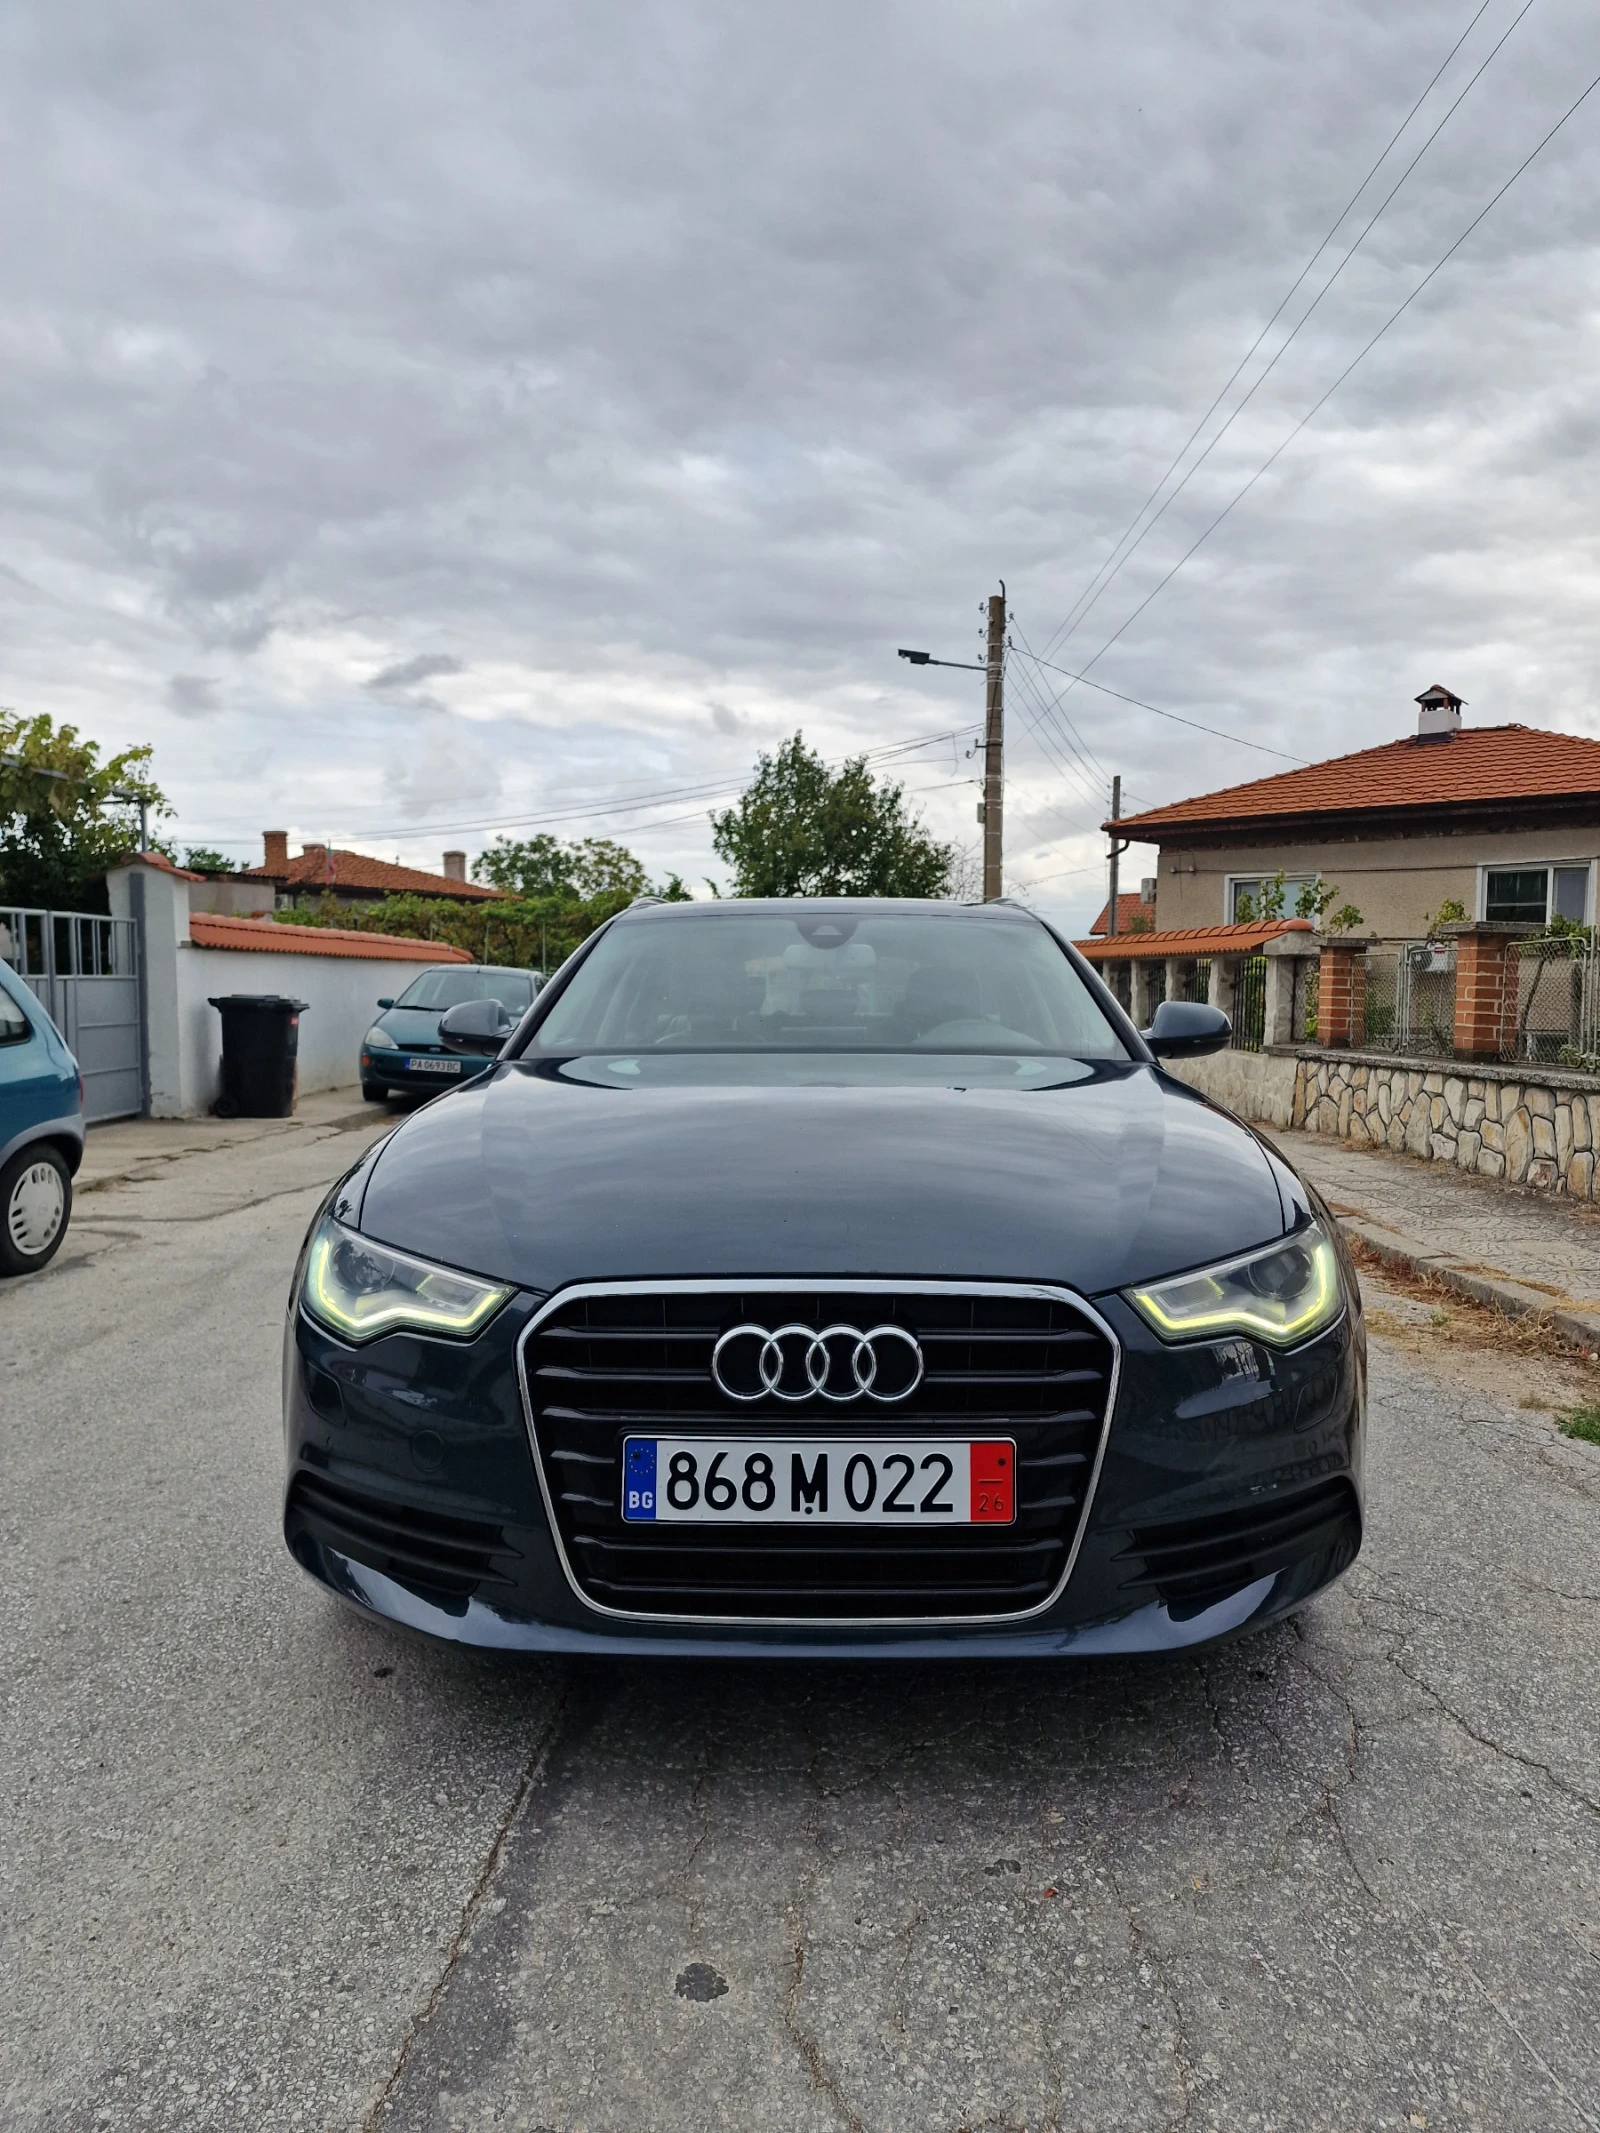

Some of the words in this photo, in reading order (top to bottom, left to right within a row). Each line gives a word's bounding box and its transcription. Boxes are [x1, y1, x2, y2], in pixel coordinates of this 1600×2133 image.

[411, 1060, 423, 1070] PA
[666, 1450, 776, 1512] 868
[790, 1453, 829, 1513] M
[843, 1453, 954, 1514] 022
[628, 1490, 654, 1509] BG
[978, 1492, 1005, 1512] 26
